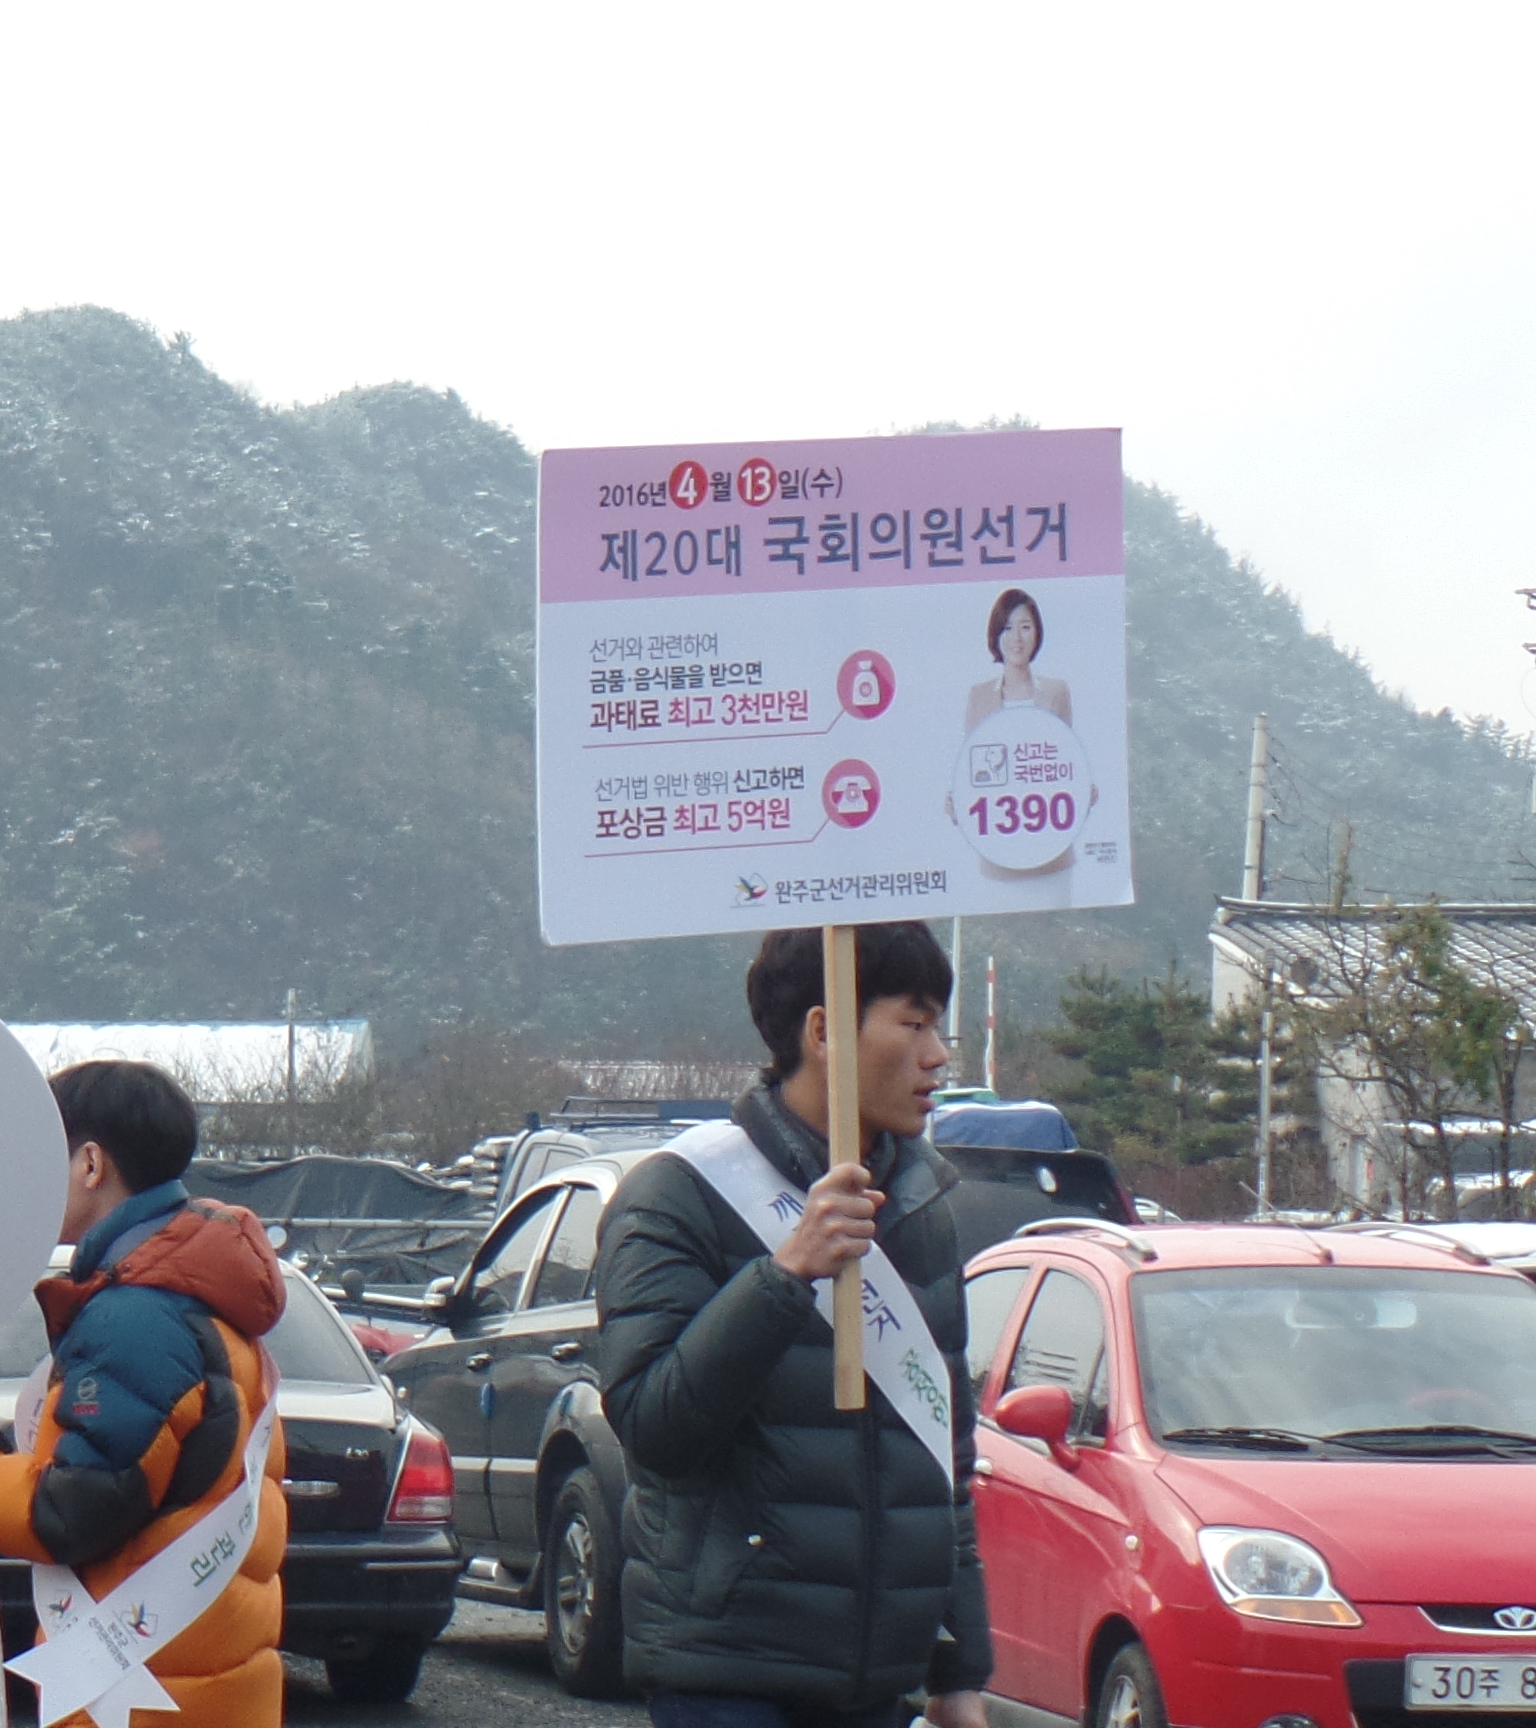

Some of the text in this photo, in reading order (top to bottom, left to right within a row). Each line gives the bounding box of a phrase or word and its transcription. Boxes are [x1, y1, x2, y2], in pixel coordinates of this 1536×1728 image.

[599, 481, 667, 507] 2016년
[599, 503, 1067, 581] 제20대 국회의원선거
[589, 632, 719, 663] 선거와 관련하여
[710, 661, 763, 688] 받으면
[589, 689, 810, 732] 과태료 최고 3천만원
[1013, 741, 1059, 762] 신고는
[595, 765, 805, 802] 선거법 위반 행위 신고하면
[1014, 762, 1074, 784] 국번없이
[595, 797, 791, 840] 포상금 최고 5억원
[968, 791, 1076, 836] 1390
[775, 870, 947, 905] 완주군선거관리위원회
[190, 1529, 236, 1588] 관리
[1431, 1665, 1500, 1700] 30주
